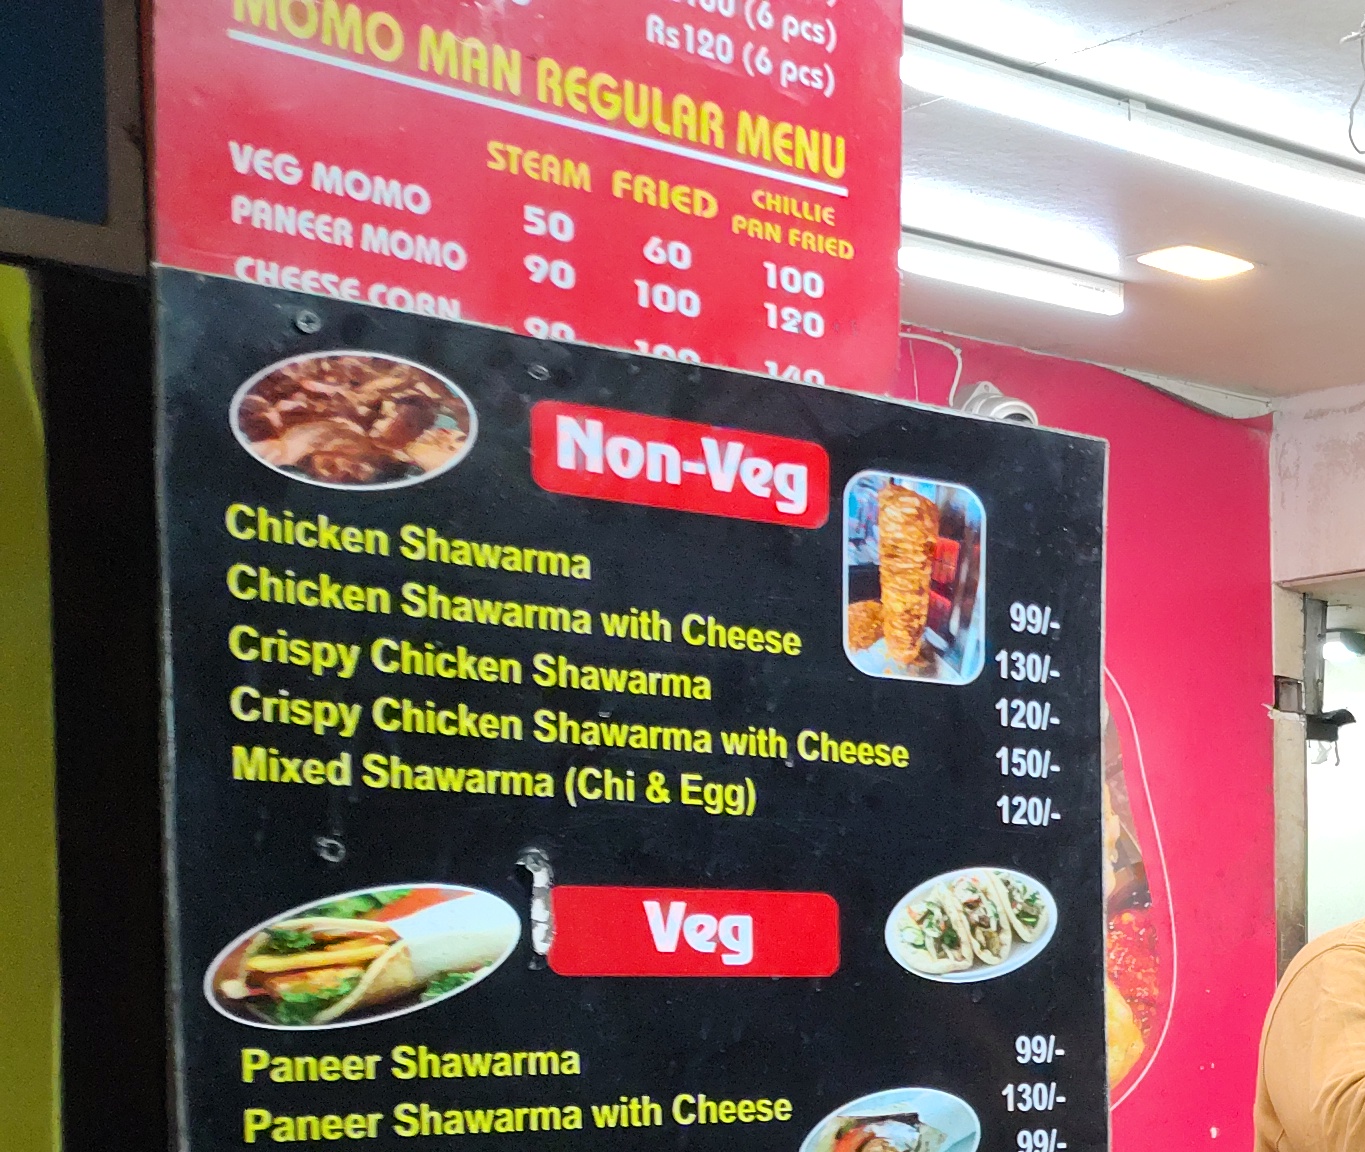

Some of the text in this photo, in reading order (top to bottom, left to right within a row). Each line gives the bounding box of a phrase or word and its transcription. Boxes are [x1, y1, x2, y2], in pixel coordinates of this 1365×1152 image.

[645, 13, 836, 98] Rs120 (6 pcs)
[781, 14, 838, 53] pcs)
[232, 0, 847, 180] MOMO MAN REGULAR MENU
[229, 141, 824, 299] VEG MOMO 50 60 100
[487, 139, 719, 220] STEAM FRIED
[751, 189, 836, 227] CHILLIE
[231, 194, 825, 339] PANEER MOMO 90 100 120
[731, 215, 855, 261] PAN FRIED
[234, 255, 360, 301] CHEESE
[368, 281, 461, 323] CORN
[555, 414, 809, 516] Non-Veg
[225, 502, 1061, 635] Chicken Shawarma 99/-
[226, 562, 1061, 684] Chicken Shawarma with Cheese 130/-
[228, 624, 1061, 731] Crispy Chicken Shawarma 120/-
[230, 686, 1061, 779] Crispy Chicken Shawarma with Cheese 150/-
[231, 745, 1062, 827] Mixed Shawarma (Chi & Egg) 120/-
[643, 899, 754, 966] Veg
[242, 1034, 1065, 1084] Paneer Shawarma 99/-
[243, 1082, 1066, 1143] Paneer Shawarma with Cheese 130/-
